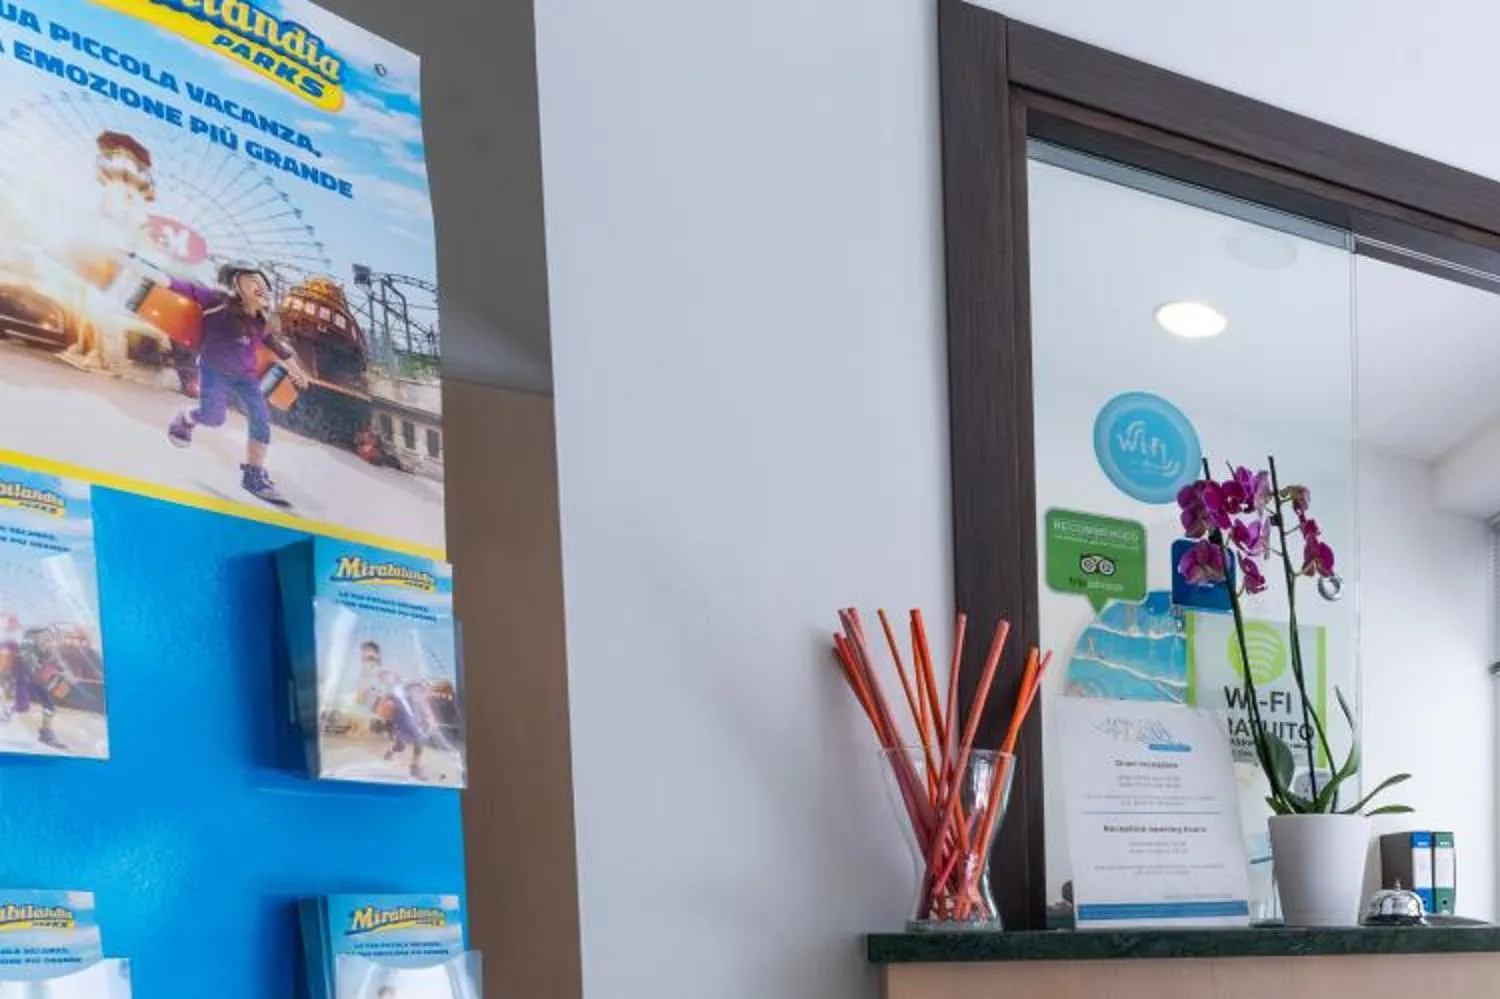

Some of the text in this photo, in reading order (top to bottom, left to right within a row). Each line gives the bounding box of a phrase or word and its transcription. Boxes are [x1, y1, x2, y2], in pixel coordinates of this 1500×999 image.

[14, 39, 353, 199] EMOZIONE PIÙ GRANDE
[49, 21, 180, 95] PICCOLA
[185, 81, 322, 157] VACANZA,
[211, 33, 324, 98] PARKS
